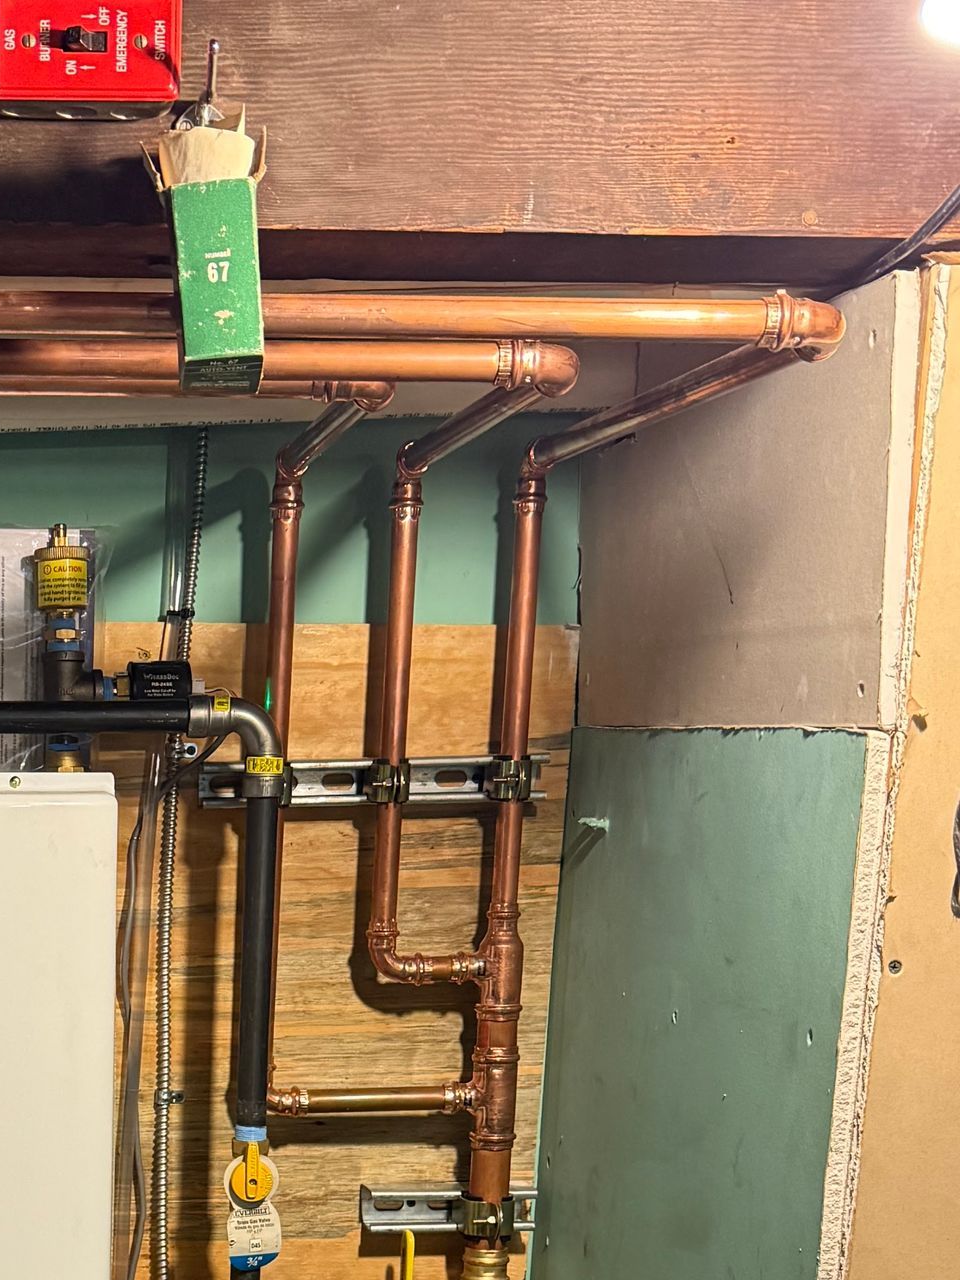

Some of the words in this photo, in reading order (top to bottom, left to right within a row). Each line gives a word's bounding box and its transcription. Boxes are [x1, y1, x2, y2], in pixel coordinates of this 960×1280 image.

[99, 6, 110, 25] OFF
[4, 29, 16, 50] GAS
[116, 9, 128, 72] EMERGENCY
[155, 20, 166, 60] SWITCH
[66, 60, 77, 75] ON
[207, 261, 230, 283] 67
